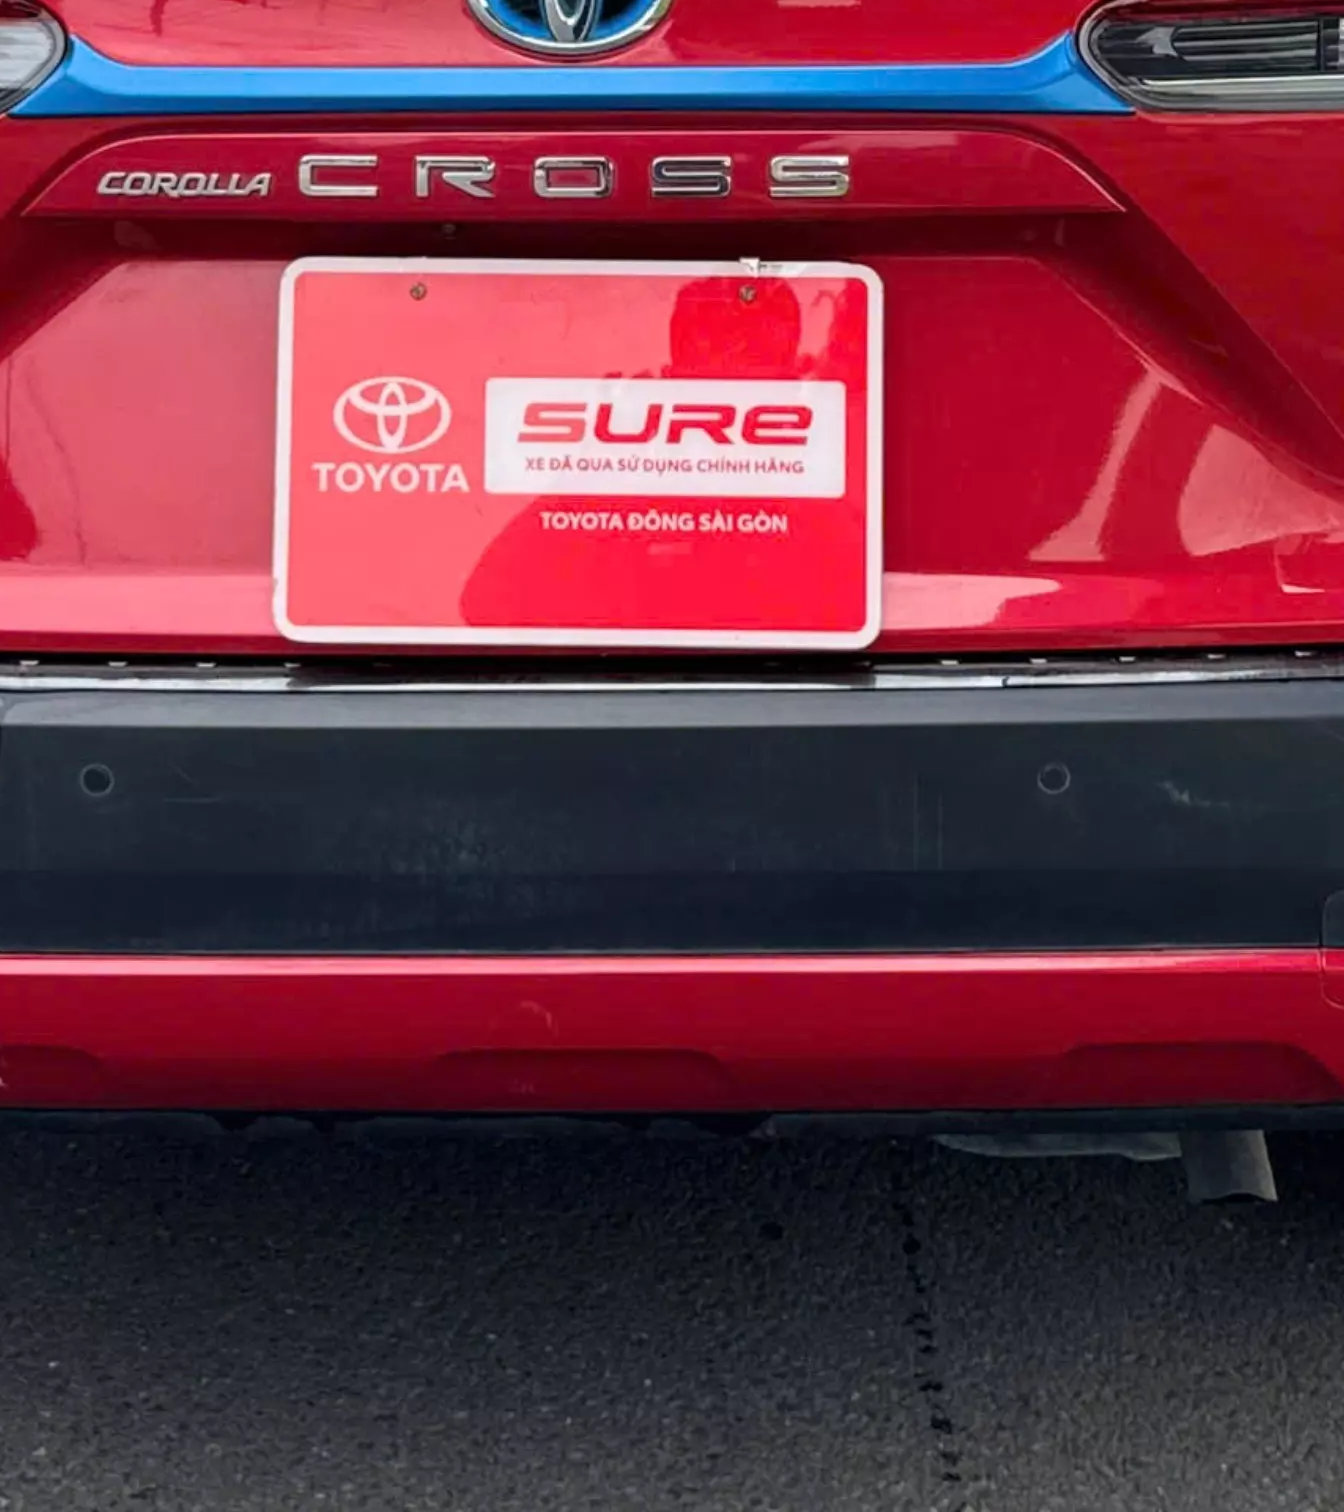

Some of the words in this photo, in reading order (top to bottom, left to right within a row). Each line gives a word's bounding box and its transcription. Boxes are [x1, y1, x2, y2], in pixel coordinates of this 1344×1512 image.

[97, 170, 273, 198] COROLLA
[297, 153, 851, 200] CROSS
[311, 461, 471, 494] TOYOTA
[525, 457, 546, 472] XE
[549, 455, 573, 472] ĐÃ
[576, 457, 613, 473] QUA
[643, 458, 692, 476] DỤNG
[696, 455, 751, 474] CHÍNH
[539, 510, 624, 531] TOYOTA
[626, 508, 695, 532] ĐÔNG
[699, 508, 734, 533] SÀI
[737, 509, 788, 534] GÒN
